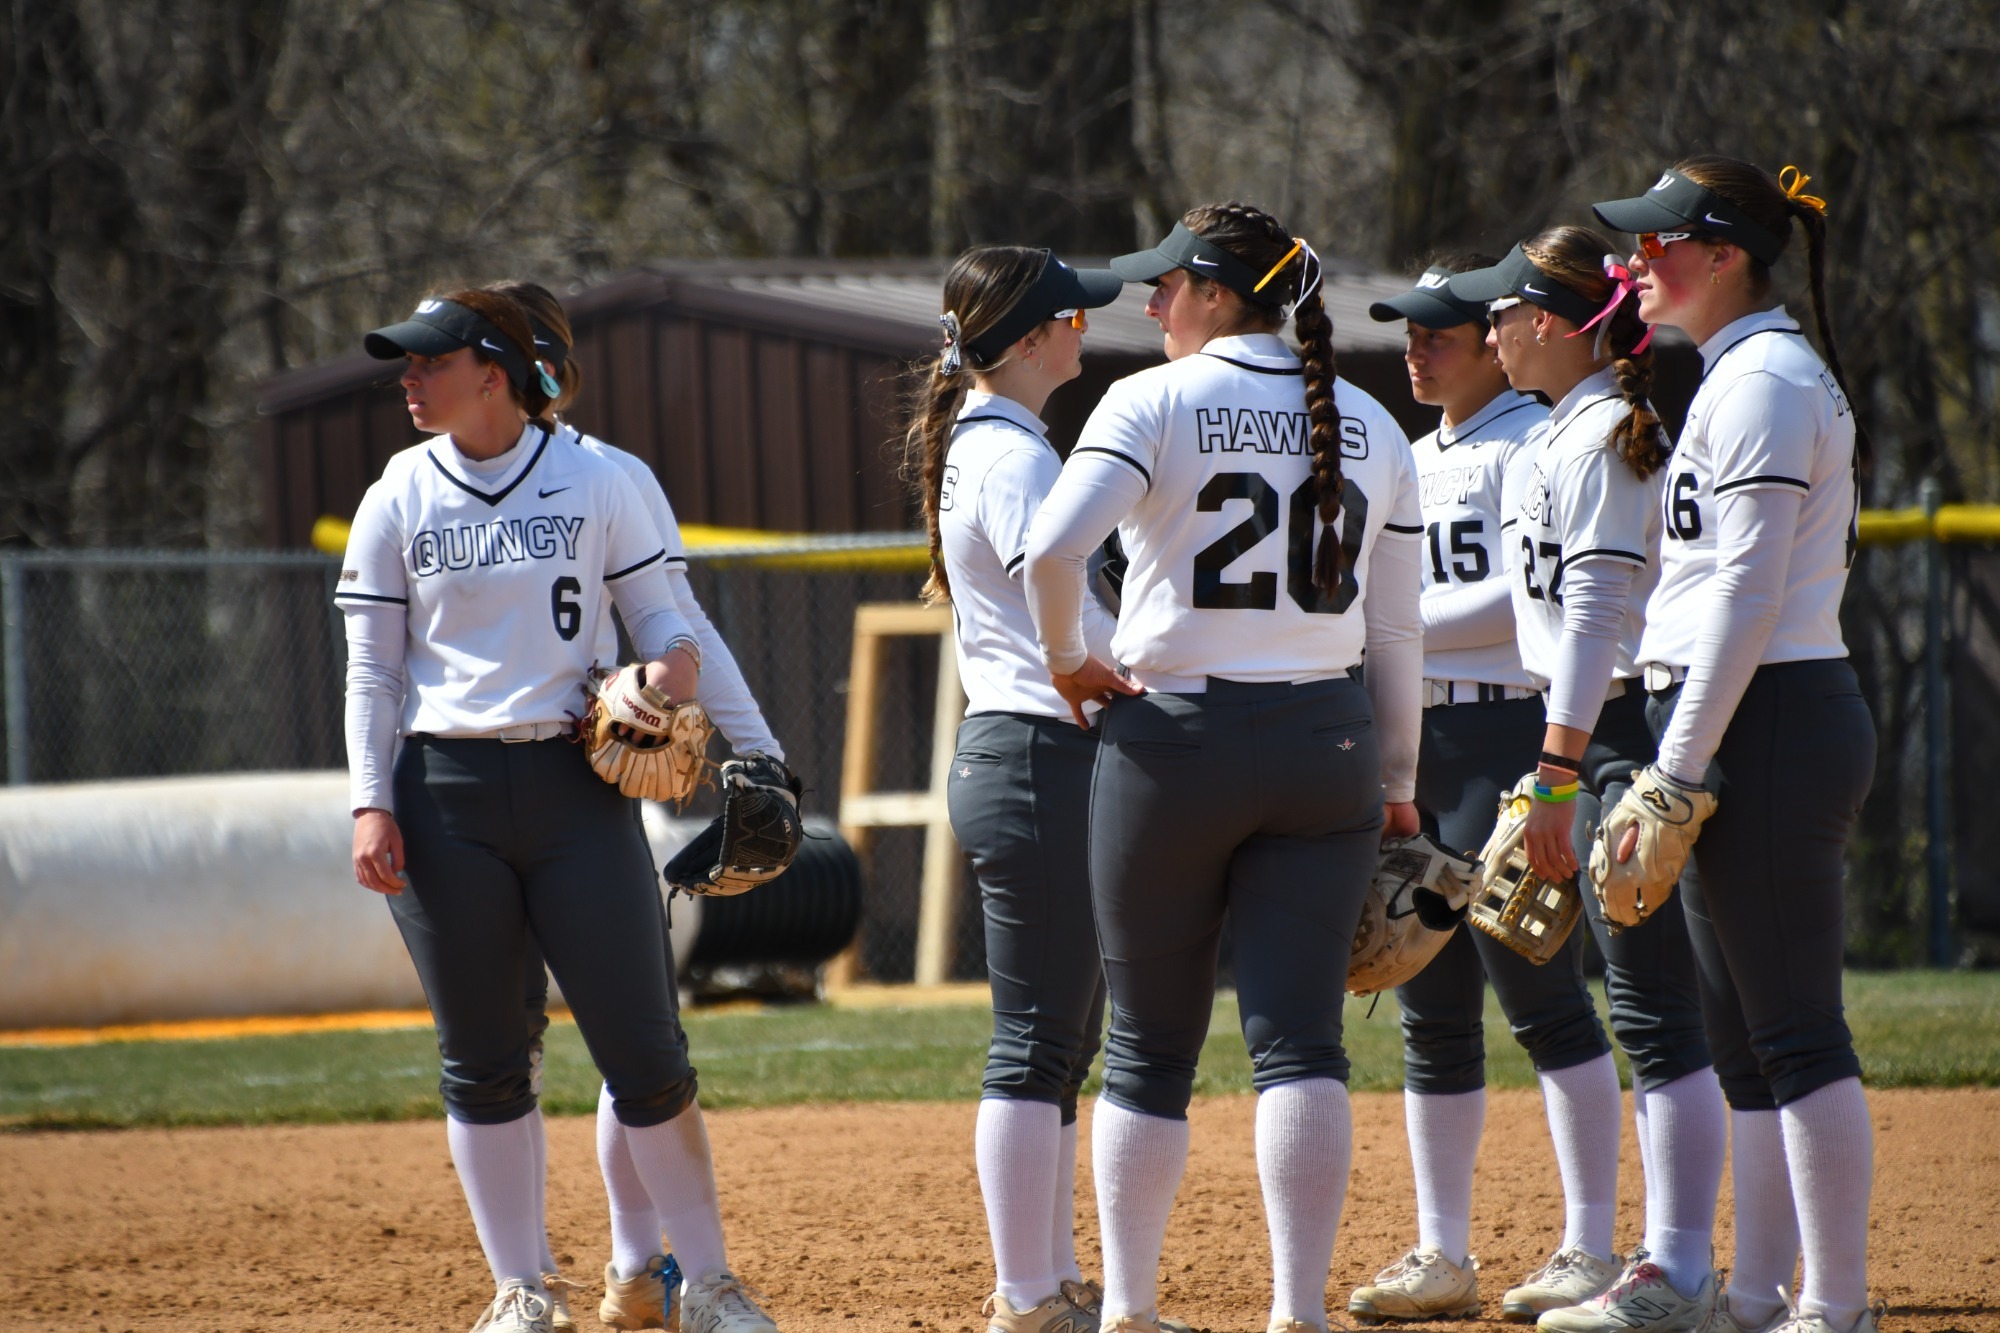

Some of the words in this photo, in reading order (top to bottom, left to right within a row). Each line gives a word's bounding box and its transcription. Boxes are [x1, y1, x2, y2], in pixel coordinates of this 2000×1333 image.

[1197, 408, 1369, 460] HAWS
[1664, 472, 1702, 541] 16
[412, 515, 585, 577] QUINCY
[1193, 472, 1369, 614] 20
[1427, 520, 1490, 583] 15
[1522, 535, 1563, 607] 27
[551, 575, 582, 641] 6
